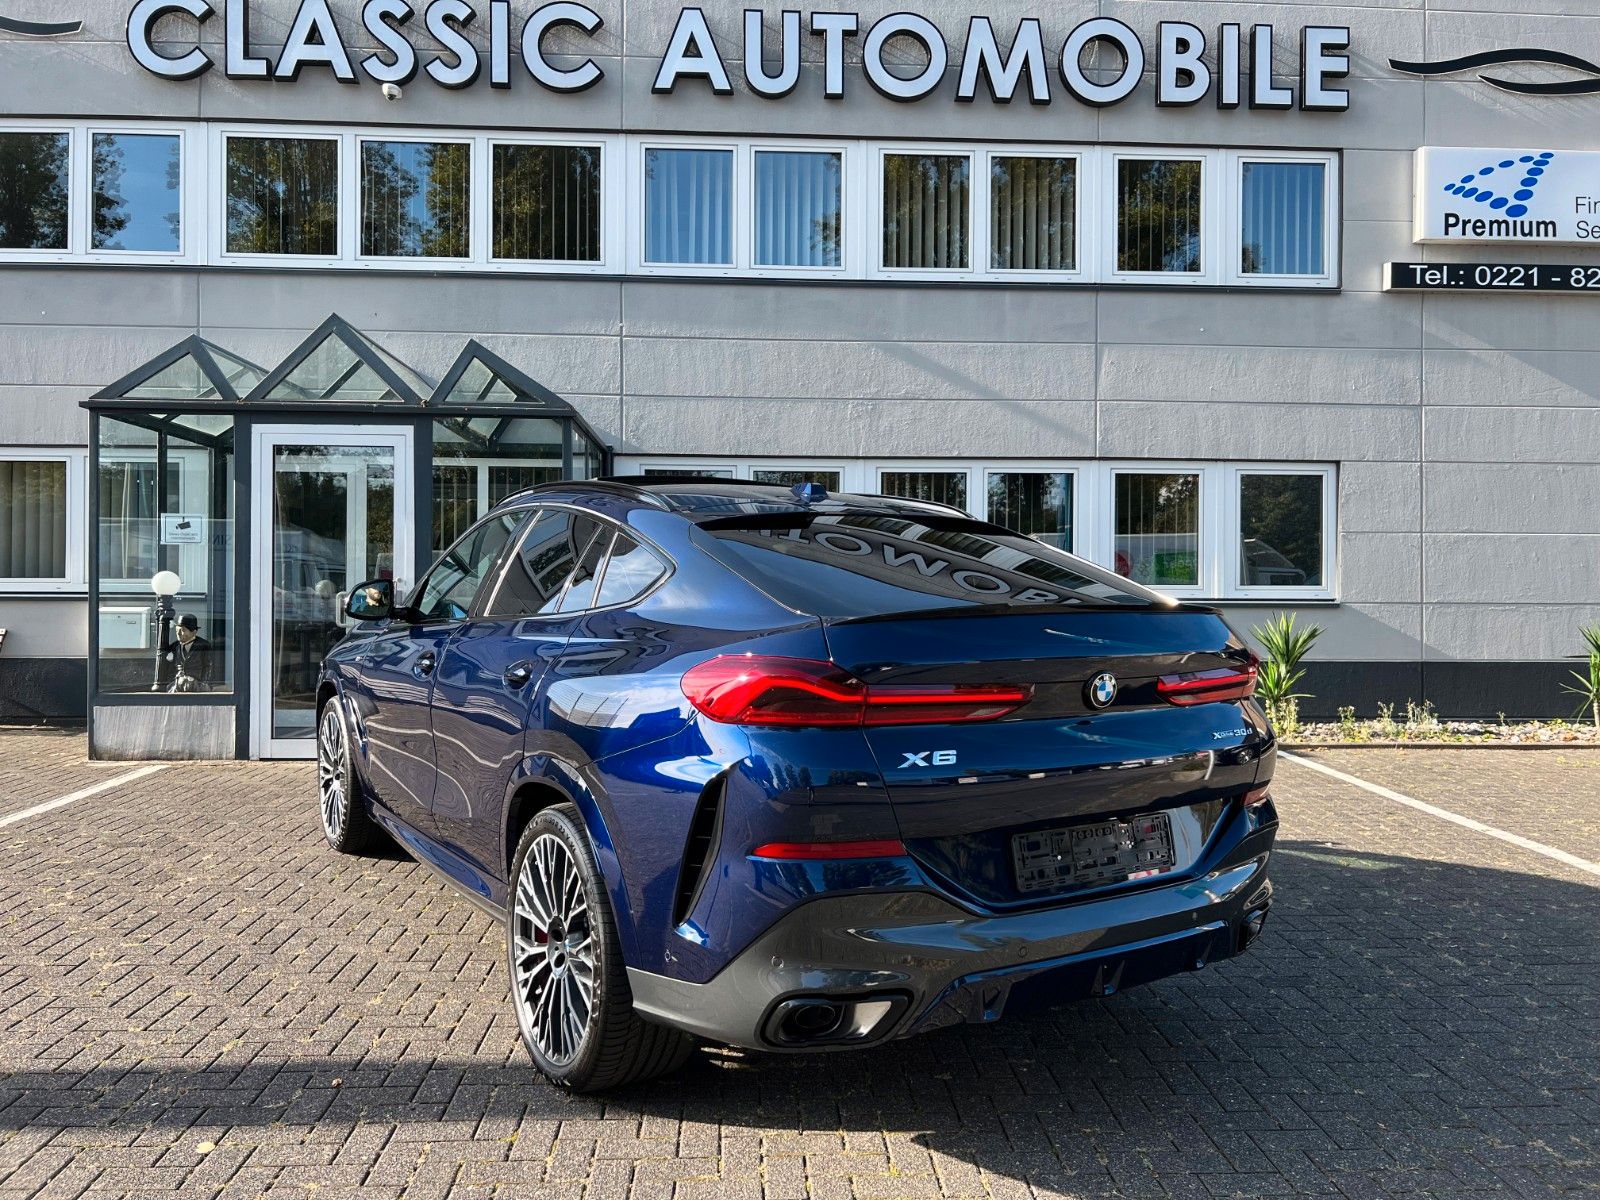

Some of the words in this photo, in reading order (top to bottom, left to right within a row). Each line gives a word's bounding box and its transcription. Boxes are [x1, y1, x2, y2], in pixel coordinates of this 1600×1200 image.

[126, 0, 604, 93] CLASSIC
[651, 7, 1350, 112] AUTOMOBILE
[1443, 212, 1557, 238] Premium
[1409, 265, 1464, 285] Tel.:
[1475, 266, 1538, 286] 0221
[1570, 267, 1600, 288] 82
[897, 749, 957, 769] X6
